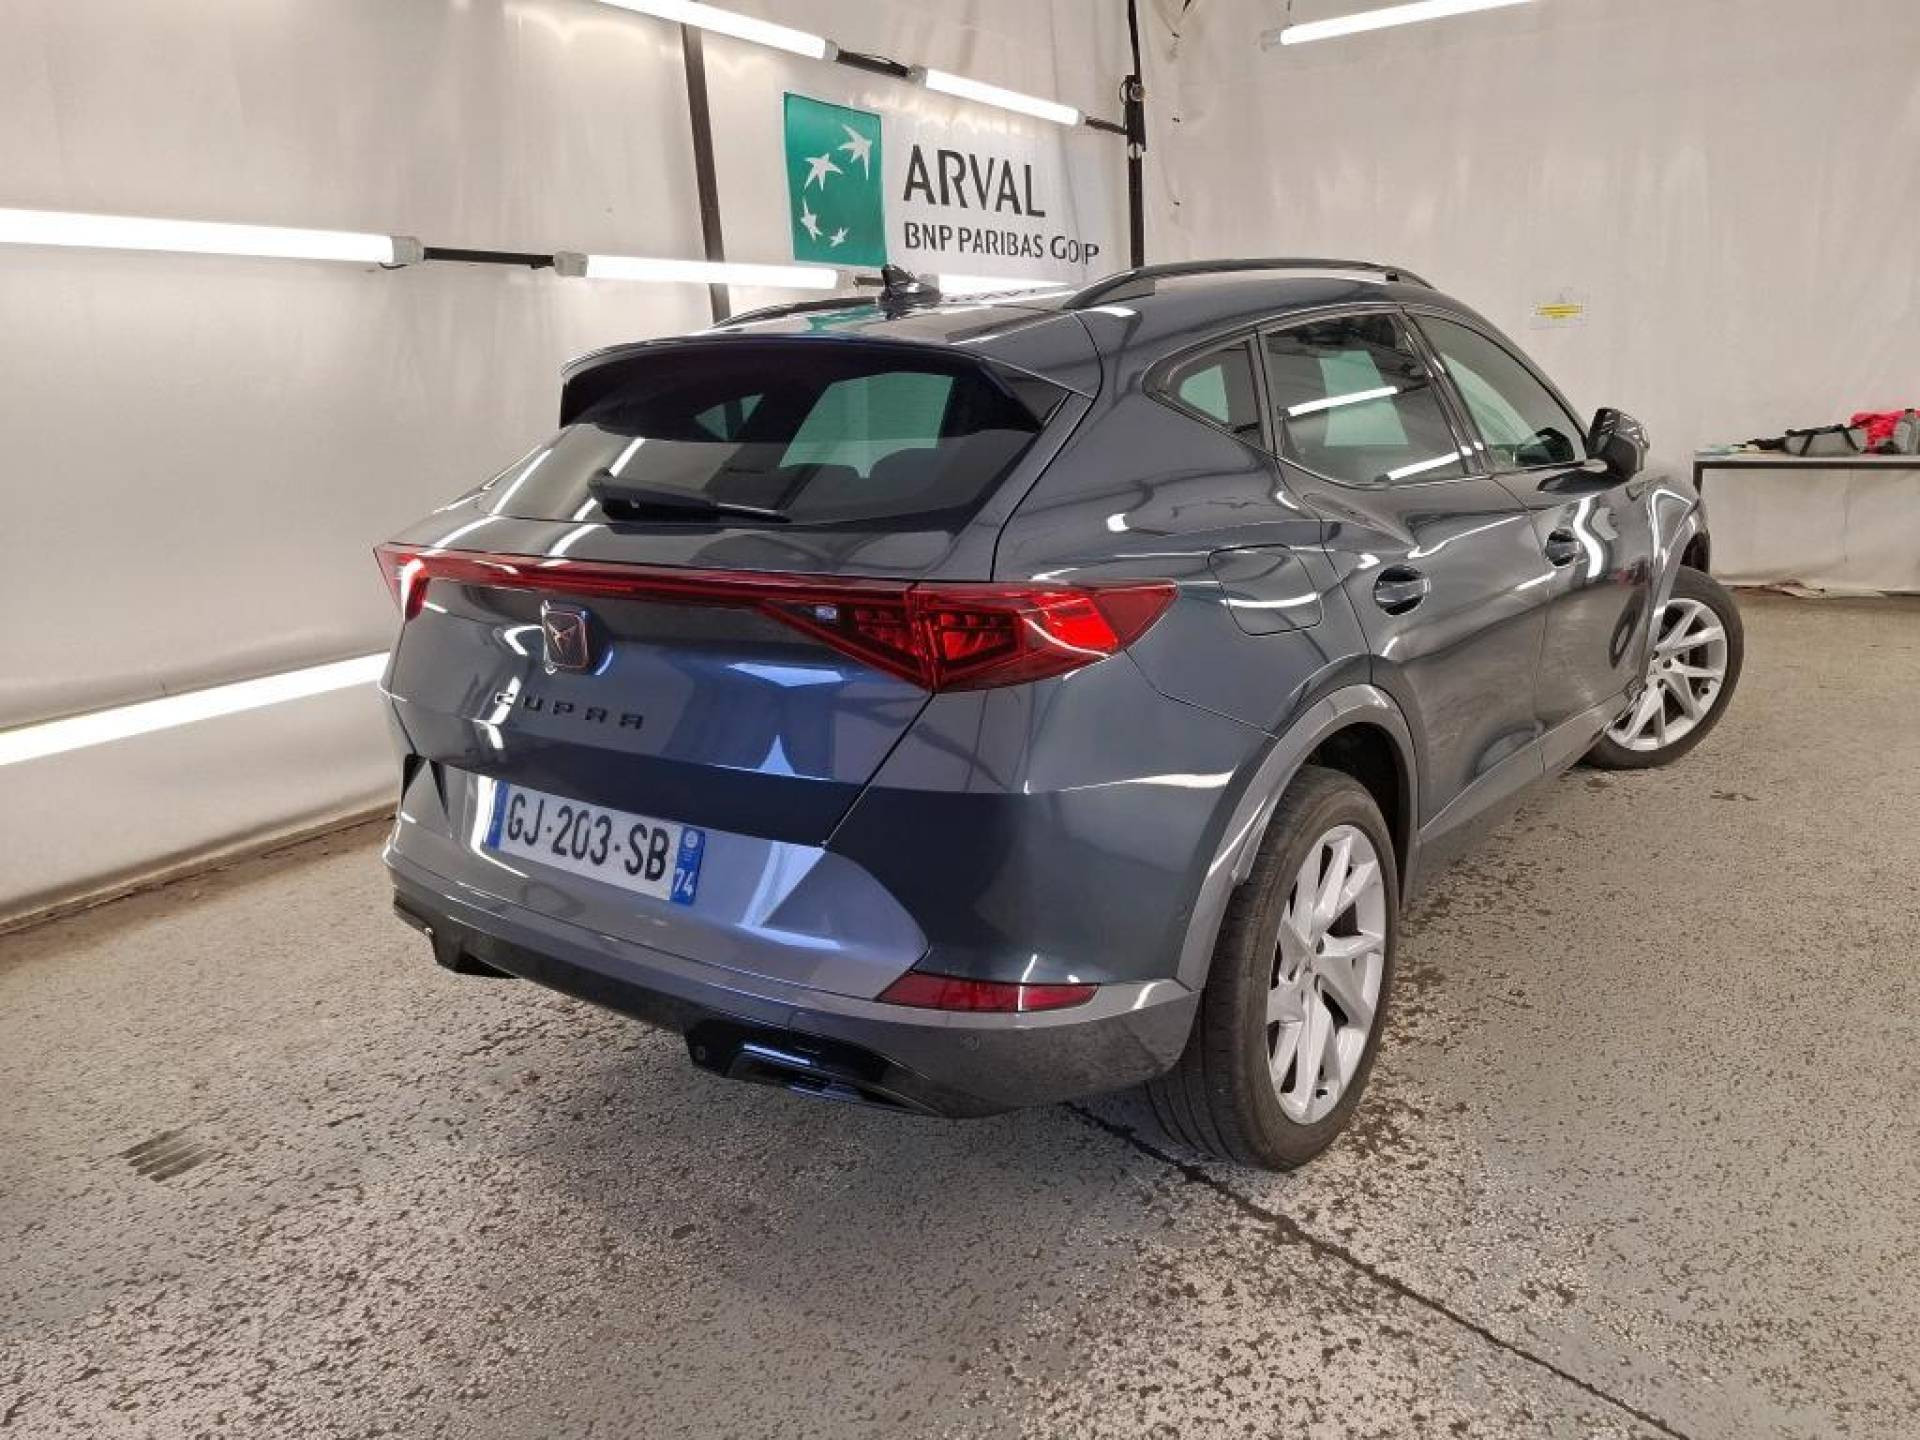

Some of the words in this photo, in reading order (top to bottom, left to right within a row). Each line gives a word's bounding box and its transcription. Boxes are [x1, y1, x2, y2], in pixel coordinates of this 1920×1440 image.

[903, 144, 1046, 218] ARVAL
[904, 221, 954, 253] BNP
[958, 227, 1043, 259] PARIBAS
[674, 867, 696, 897] 74
